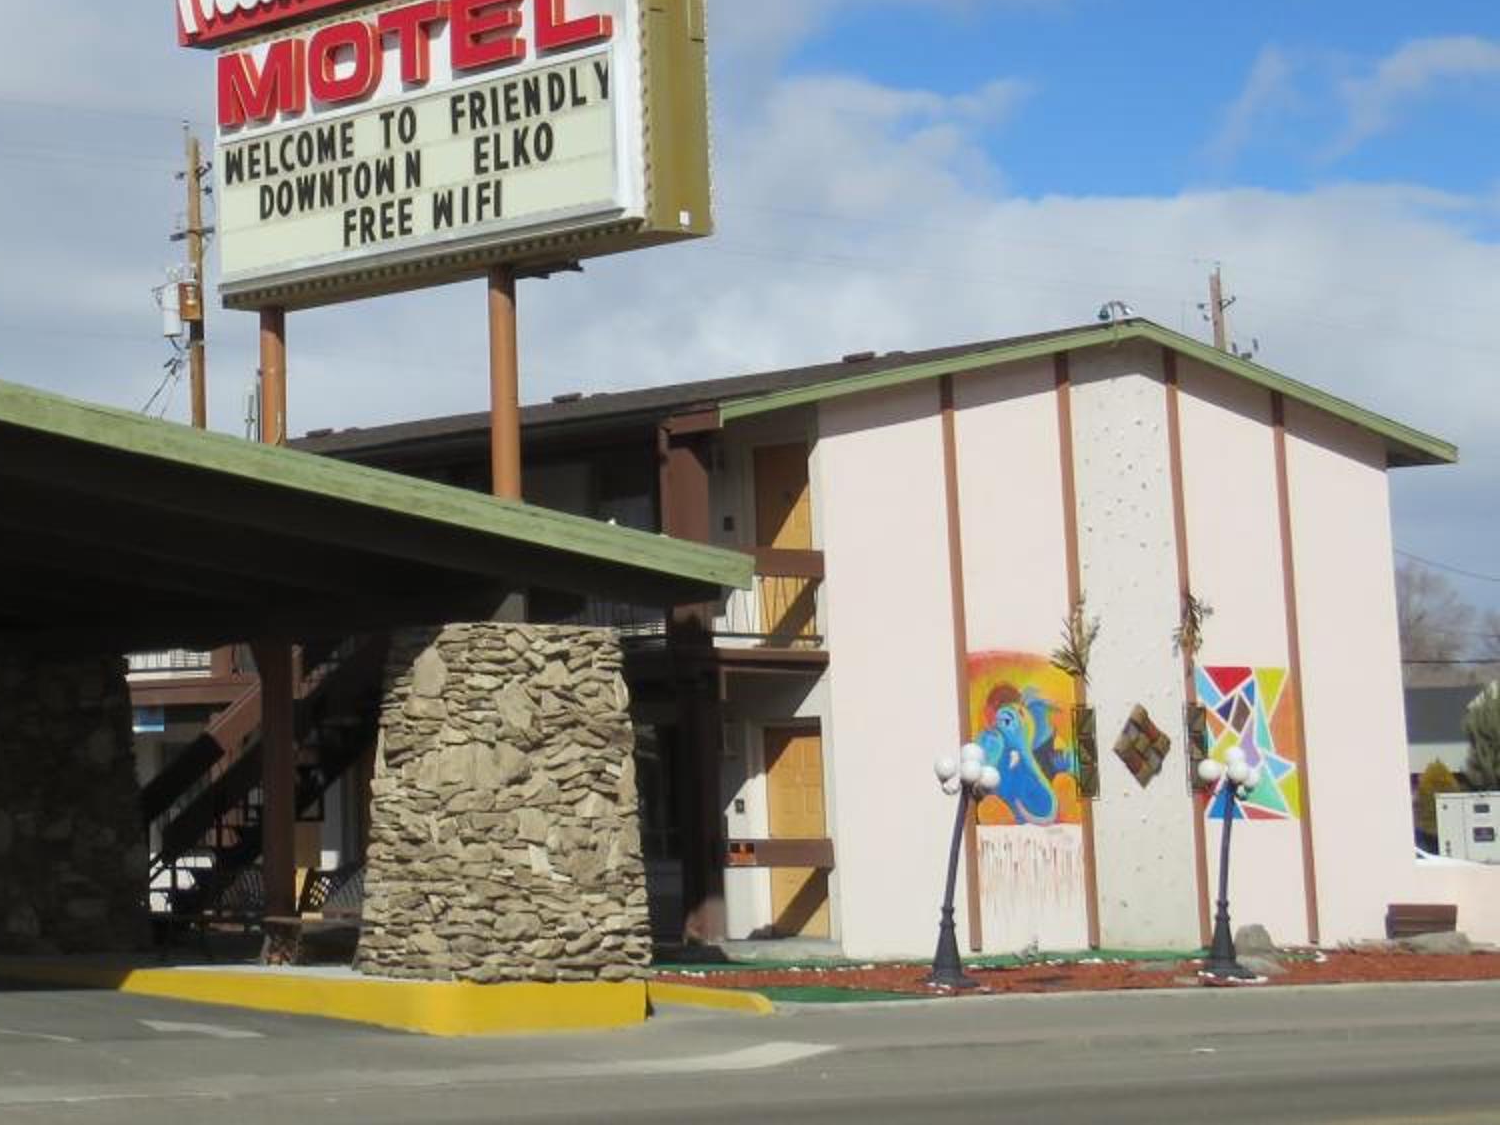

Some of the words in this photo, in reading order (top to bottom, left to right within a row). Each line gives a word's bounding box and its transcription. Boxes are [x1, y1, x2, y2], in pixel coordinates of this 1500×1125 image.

[225, 121, 354, 185] WELCOME
[380, 106, 417, 149] TO
[451, 61, 609, 135] FRIENDLY
[259, 149, 421, 220] DOWNTOWN
[473, 121, 554, 175] ELKO
[343, 197, 413, 248] FREE
[433, 179, 503, 230] WIFI
